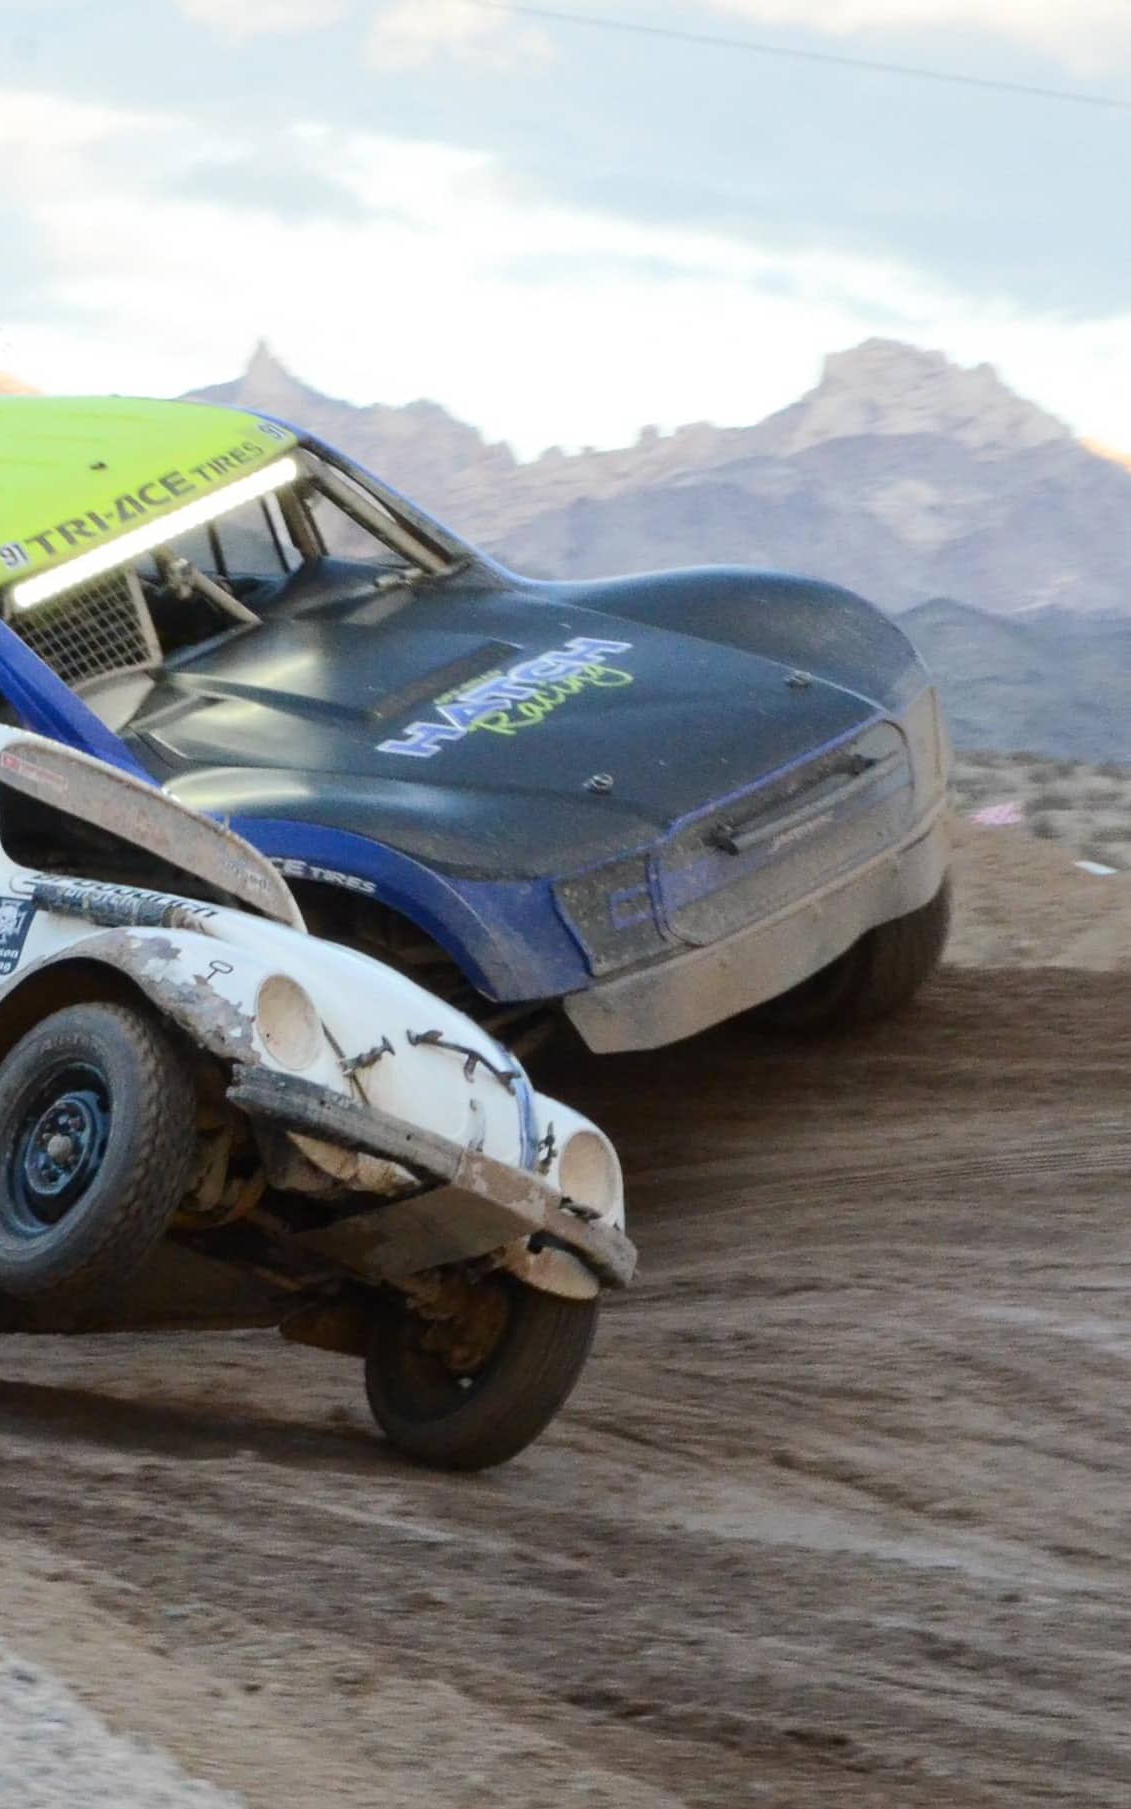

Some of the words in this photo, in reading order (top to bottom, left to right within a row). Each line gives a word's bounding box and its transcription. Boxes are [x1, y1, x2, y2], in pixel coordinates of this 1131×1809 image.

[25, 470, 198, 556] TRI-ACE
[189, 441, 264, 482] TIRES
[376, 637, 633, 758] HATCH
[467, 664, 634, 735] Racing
